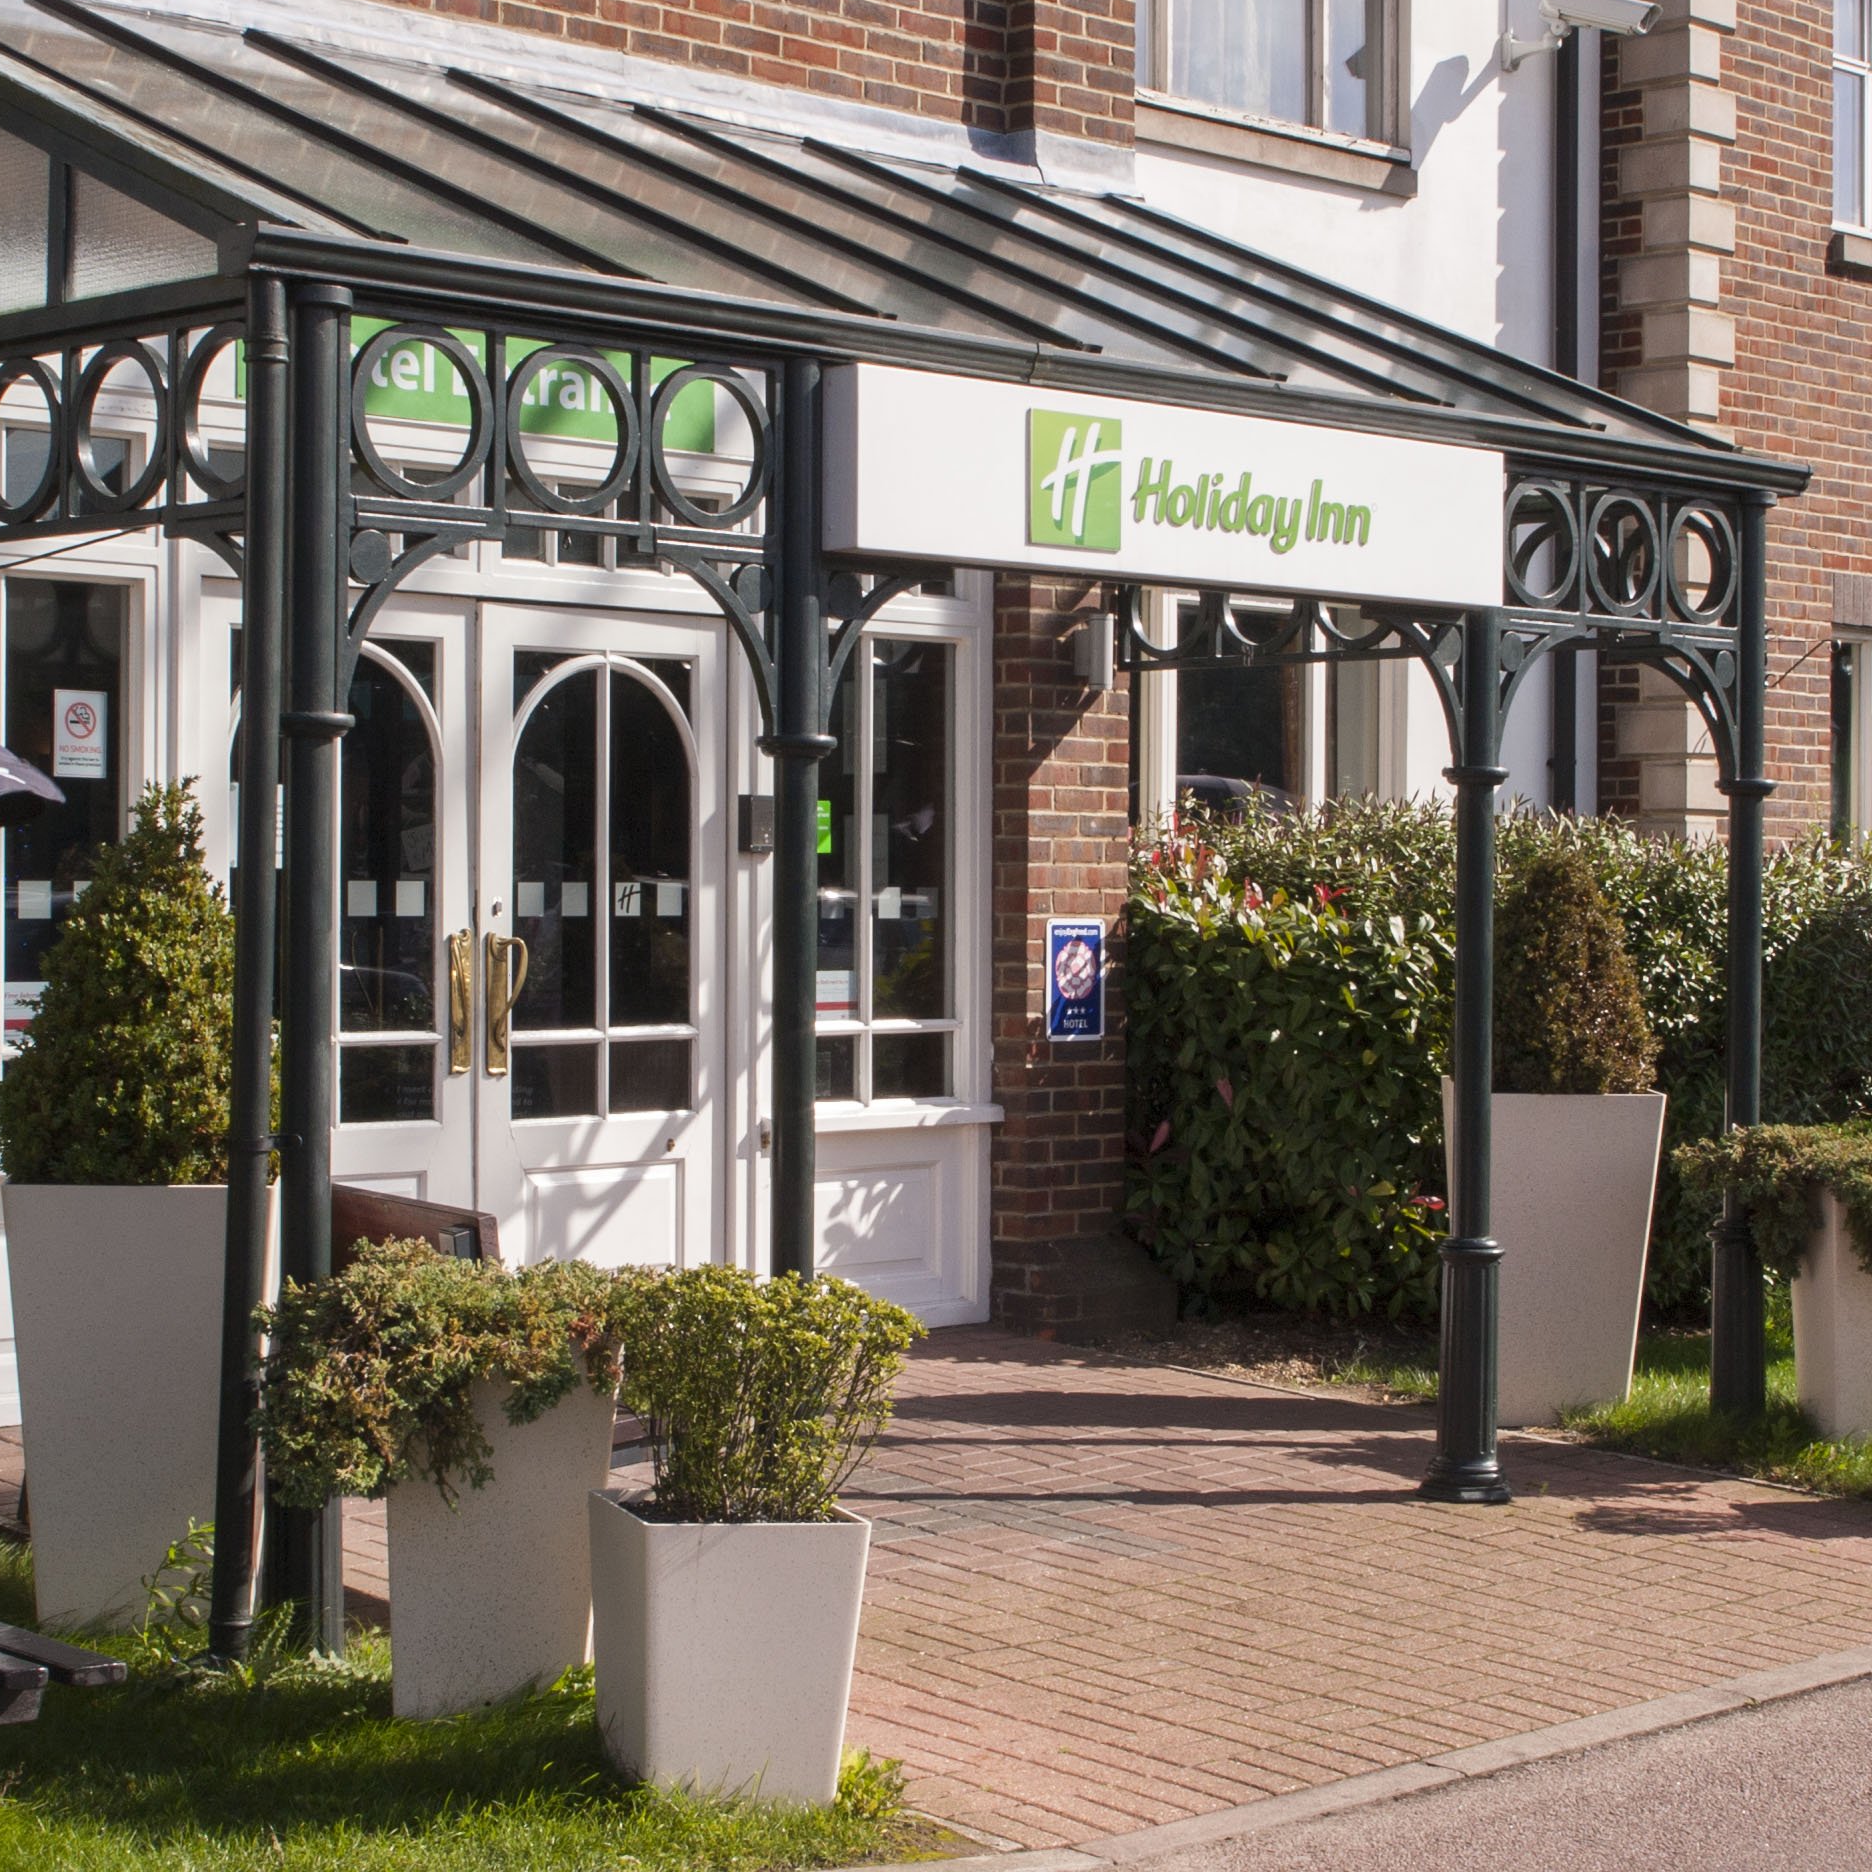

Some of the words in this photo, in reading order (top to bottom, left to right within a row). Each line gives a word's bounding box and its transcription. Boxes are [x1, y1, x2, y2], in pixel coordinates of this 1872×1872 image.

[1130, 456, 1303, 554] Holiday
[1305, 478, 1372, 547] Inn
[1063, 1018, 1089, 1029] HOTEL
